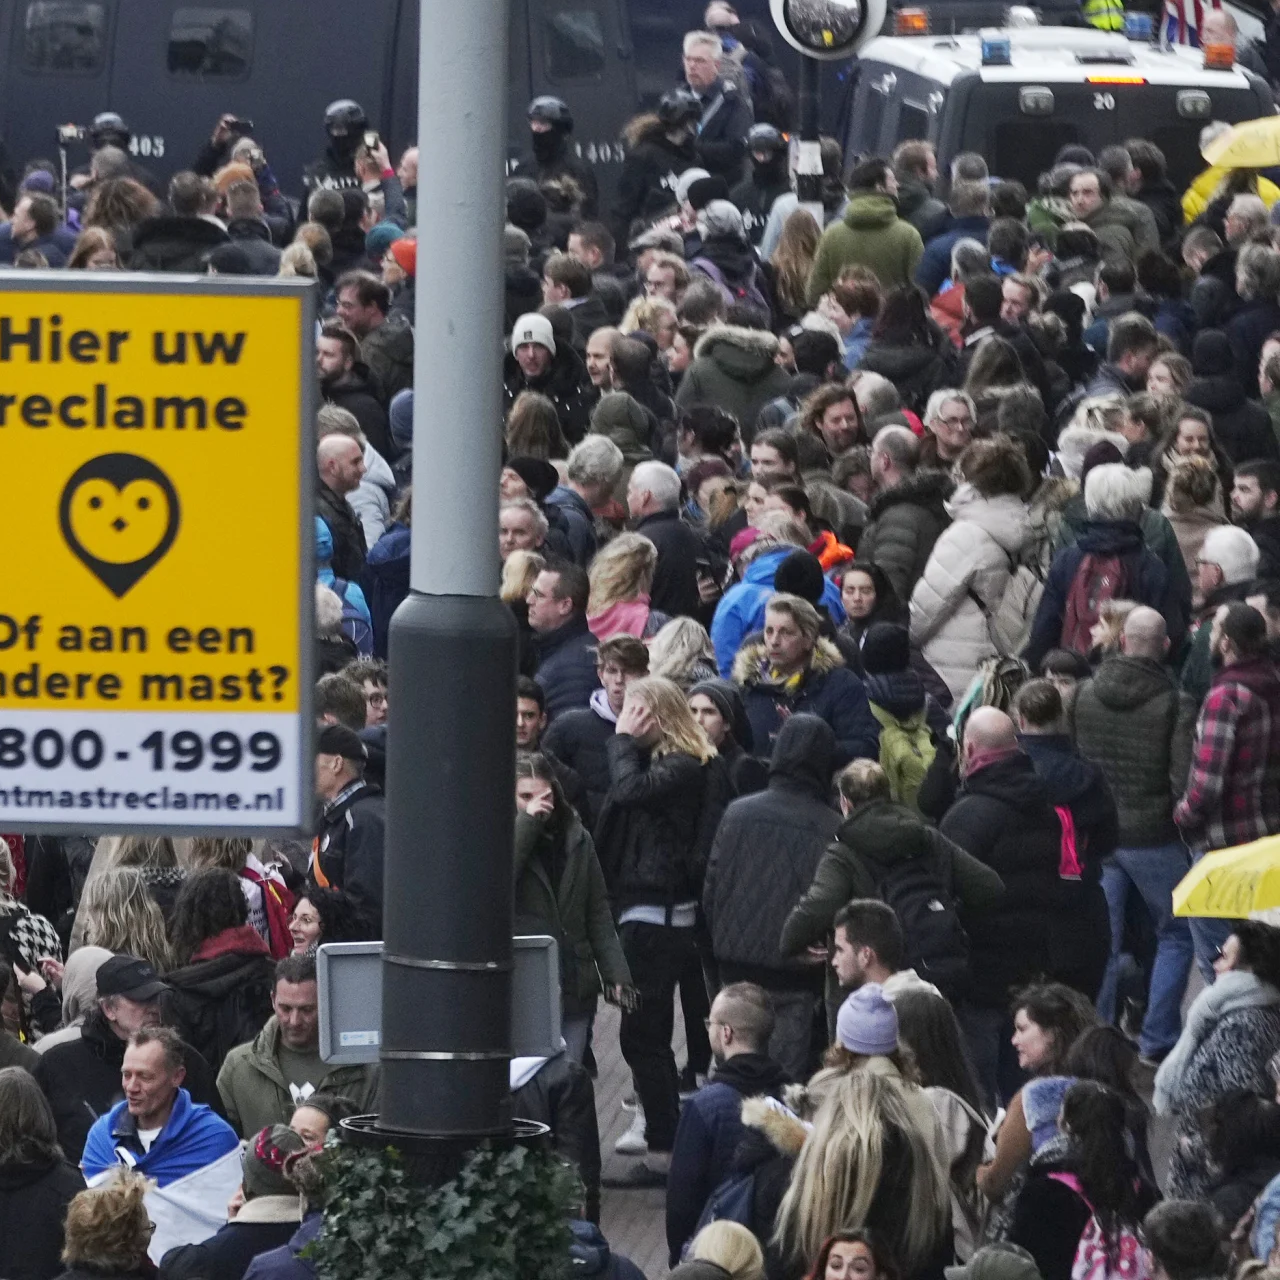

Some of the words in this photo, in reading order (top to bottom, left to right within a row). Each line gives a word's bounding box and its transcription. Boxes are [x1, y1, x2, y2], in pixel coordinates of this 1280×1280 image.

[1093, 91, 1116, 111] 20
[152, 329, 247, 365] uw
[57, 625, 148, 654] aan
[166, 626, 255, 655] een
[141, 665, 291, 703] mast?
